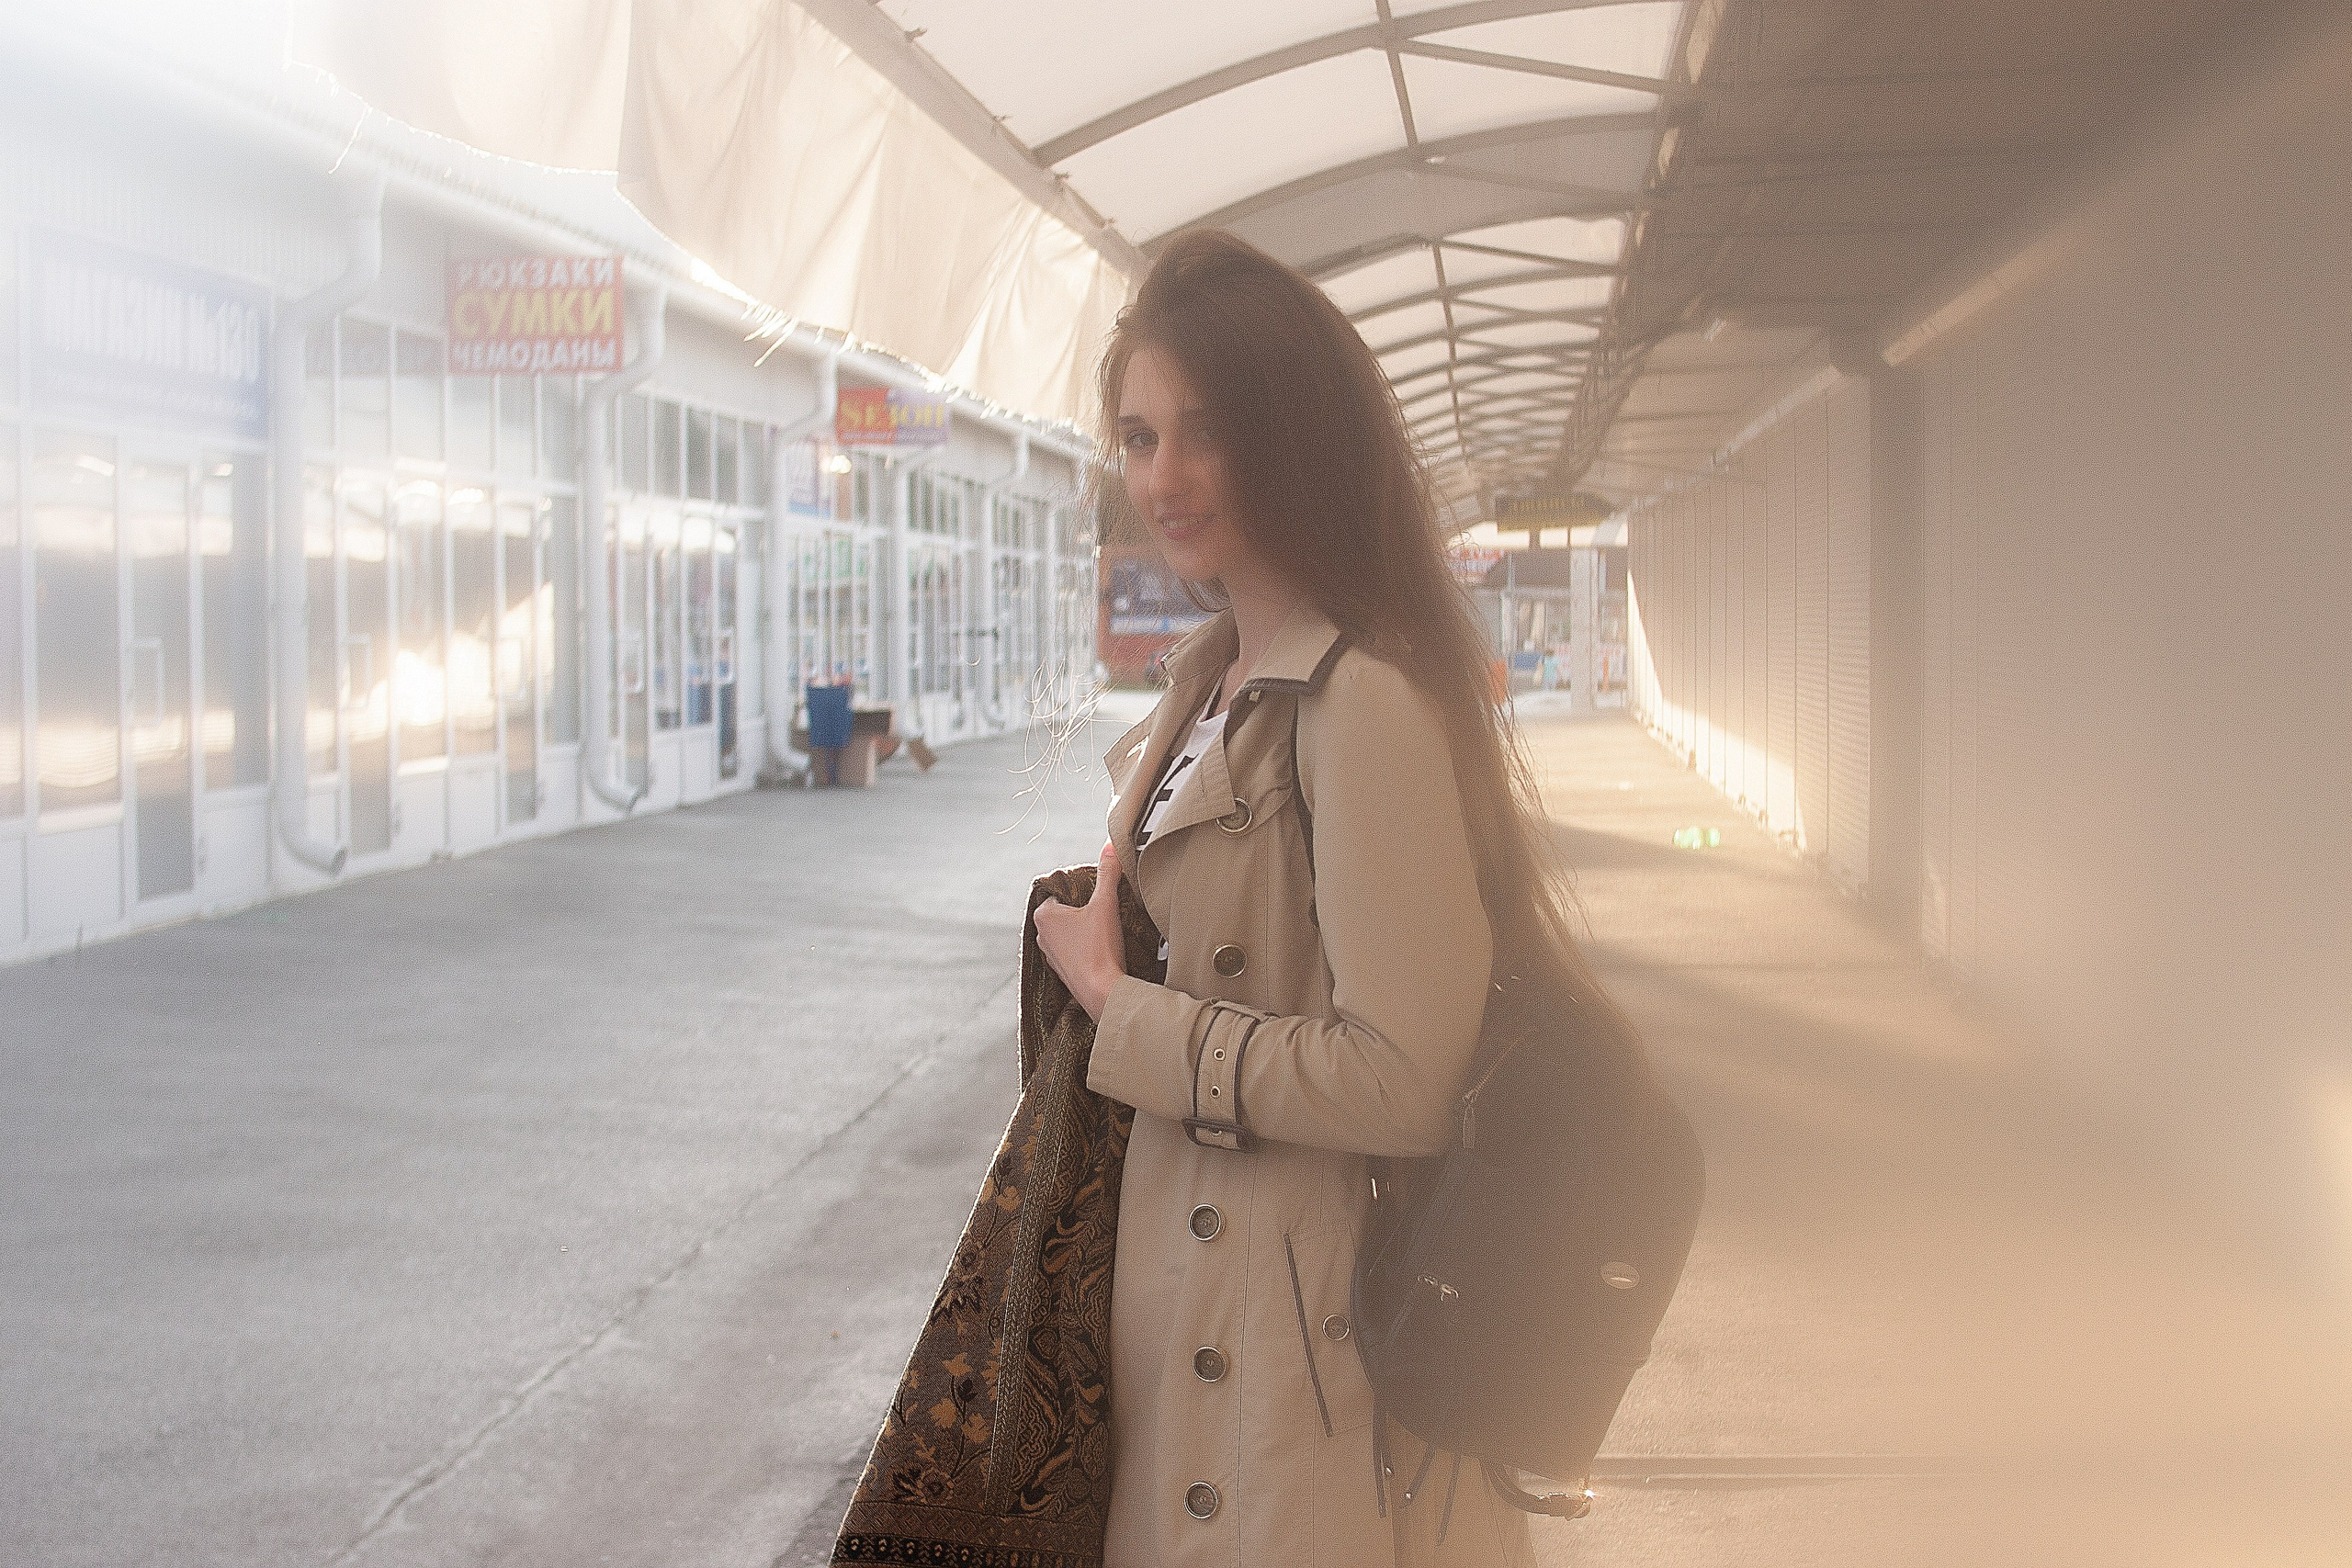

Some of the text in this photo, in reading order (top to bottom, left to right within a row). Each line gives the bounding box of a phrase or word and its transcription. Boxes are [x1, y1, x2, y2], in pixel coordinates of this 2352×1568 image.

[458, 256, 615, 288] РЮКЗАКИ
[454, 288, 615, 338] СУМКИ
[453, 338, 616, 371] ЧЕМОДАНЫ
